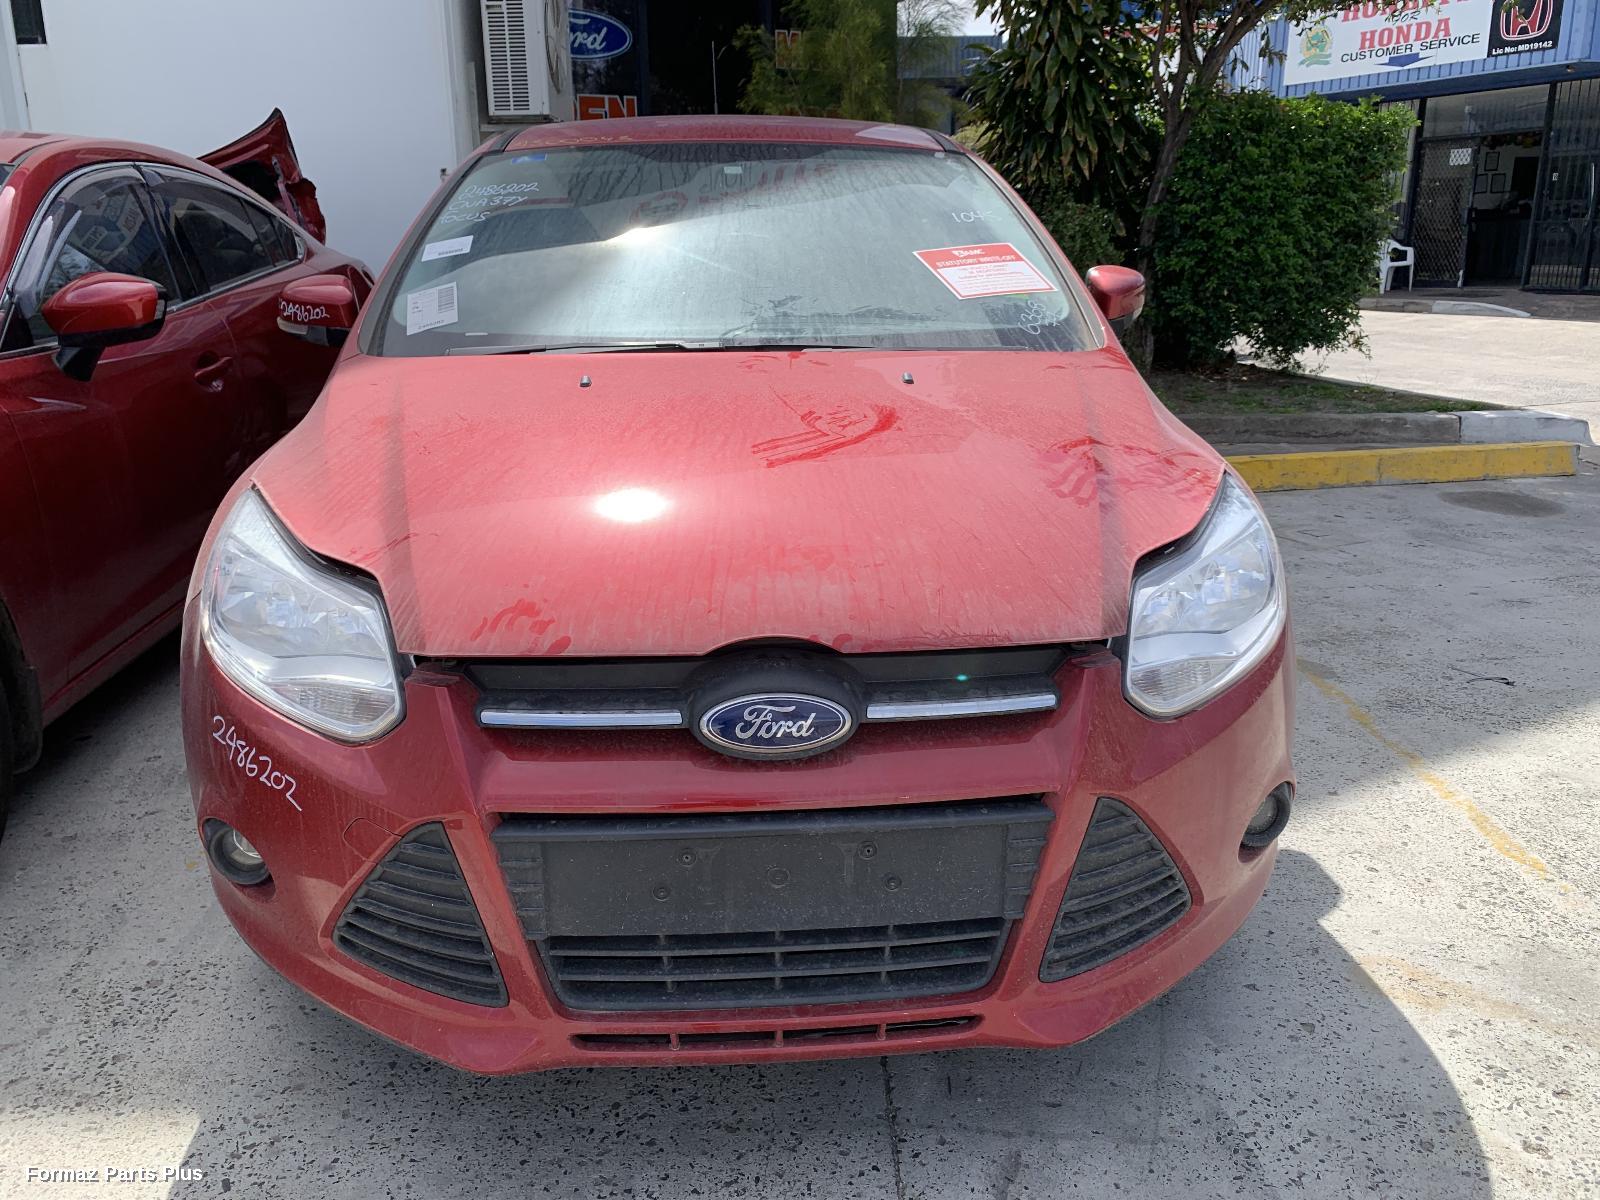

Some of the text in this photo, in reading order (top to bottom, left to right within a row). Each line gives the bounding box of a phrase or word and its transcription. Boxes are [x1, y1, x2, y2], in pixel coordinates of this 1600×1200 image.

[1341, 33, 1480, 62] CUSTOMER SERVICE
[1359, 18, 1451, 50] HONDA
[1518, 41, 1552, 52] MD19142
[574, 93, 638, 120] EN
[458, 182, 540, 201] 2486202
[280, 301, 330, 322] 2486202
[735, 704, 816, 739] Ford
[212, 715, 302, 812] 2486202
